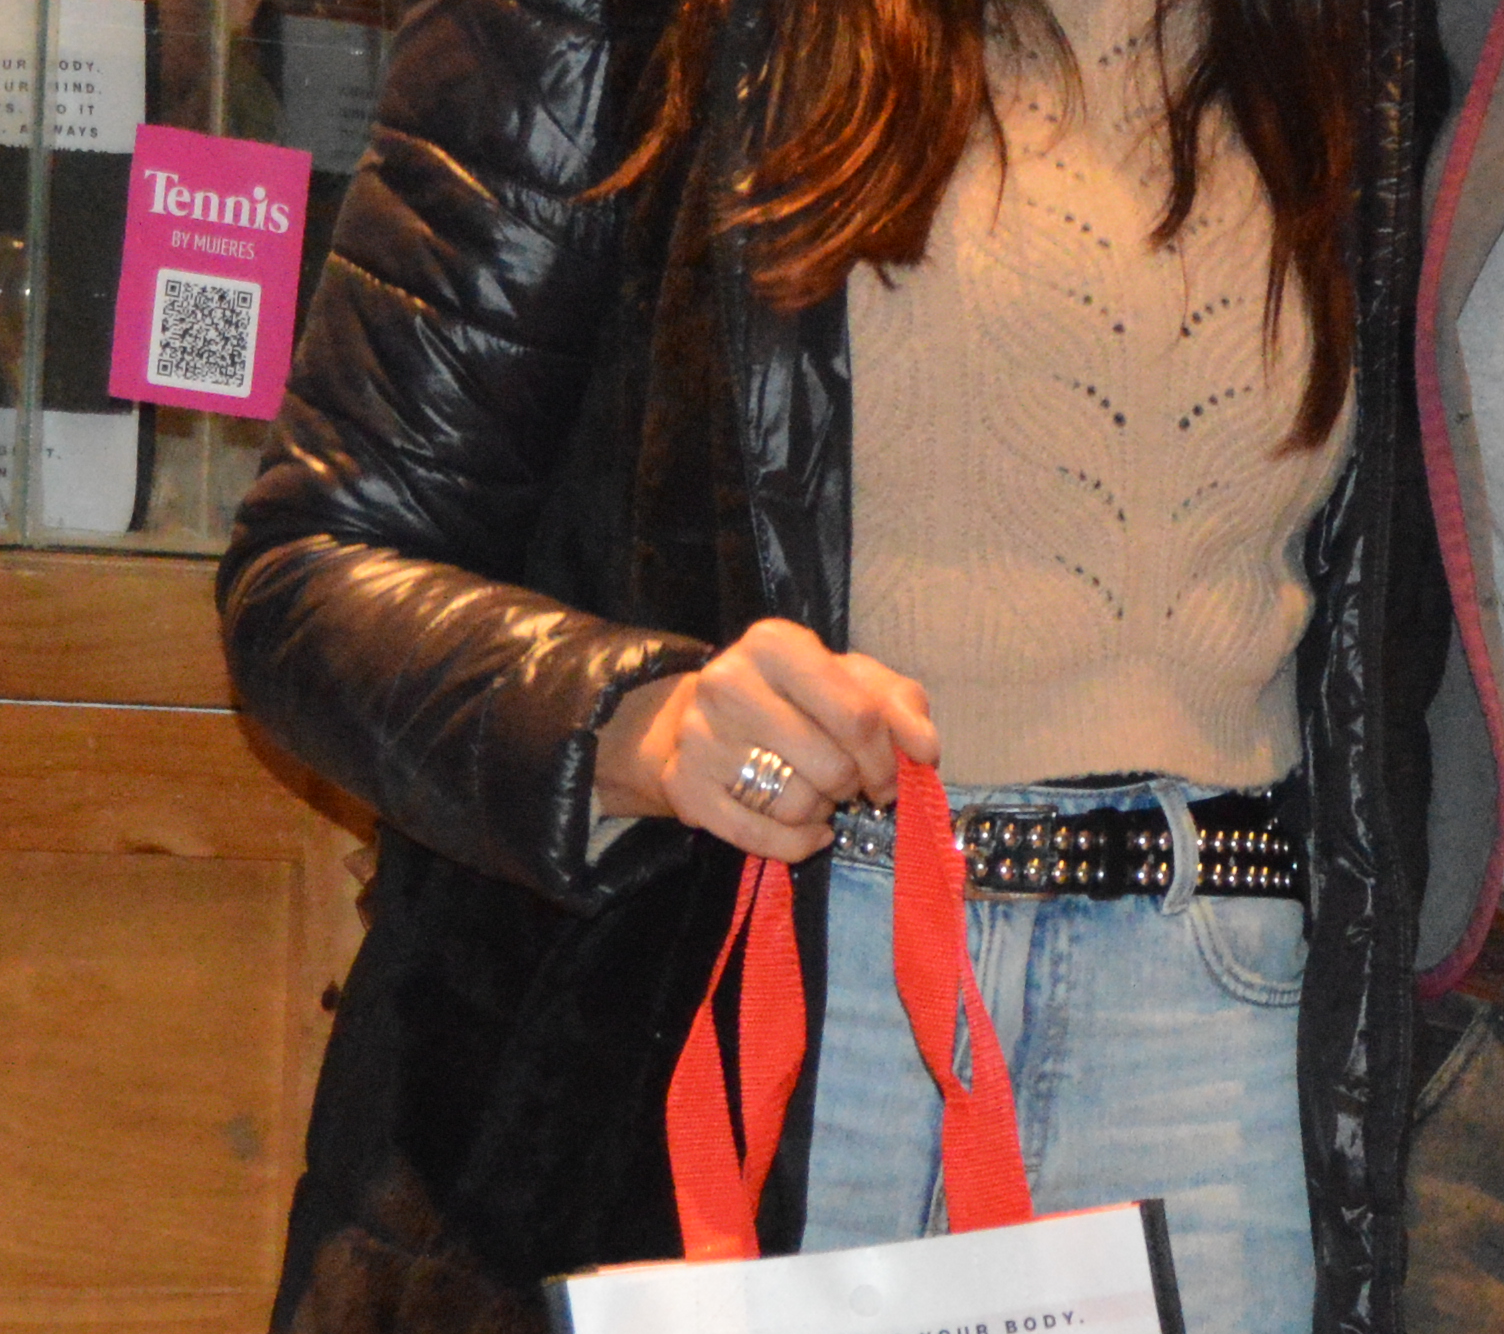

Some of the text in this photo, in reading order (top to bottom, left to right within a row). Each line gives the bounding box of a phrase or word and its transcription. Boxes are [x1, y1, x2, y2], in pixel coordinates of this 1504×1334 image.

[144, 168, 291, 235] Tennis
[171, 229, 255, 261] BY MUJERES
